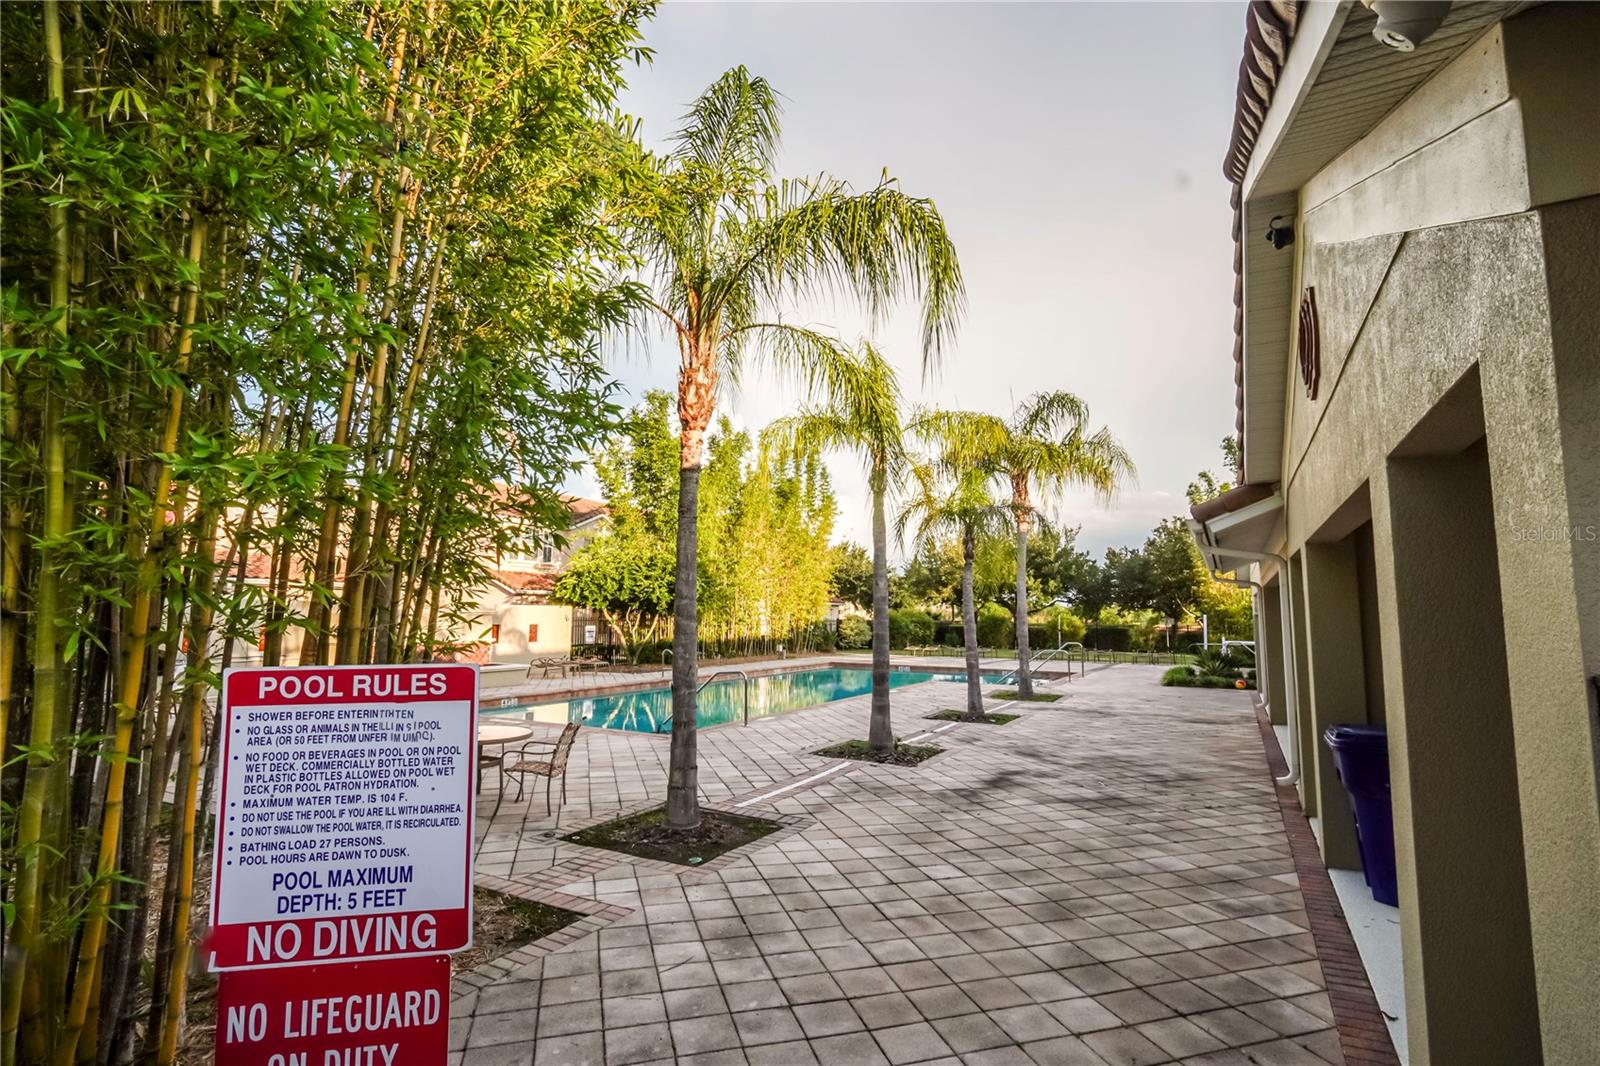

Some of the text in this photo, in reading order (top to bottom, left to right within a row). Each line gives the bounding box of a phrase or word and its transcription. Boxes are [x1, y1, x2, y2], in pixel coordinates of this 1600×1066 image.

[259, 673, 447, 699] POOL RULES
[248, 712, 292, 721] SHOWER
[296, 711, 335, 720] BEFORE
[248, 726, 260, 735] NO
[264, 725, 293, 734] GLASS
[296, 725, 308, 733] OR
[311, 723, 349, 733] ANIMALS
[352, 723, 359, 731] IN
[247, 737, 272, 746] AREA
[276, 736, 291, 747] (OR
[295, 735, 305, 744] 50
[307, 735, 329, 744] FEET
[331, 733, 356, 743] FROM
[246, 746, 461, 762] NO FOOD OR BEVERAGES IN POOL OR ON POOL
[246, 757, 453, 772] WET DECK. COMMERCIALLY BOTTLED WATER
[244, 767, 455, 783] IN PLASTIC BOTTLES ALLOWED ON POOL WET
[244, 779, 419, 794] DECK FOR POOL PATRON HYDRATION.
[243, 793, 407, 808] MAXIMUM WATER TEMP. IS 104 F.
[242, 804, 463, 822] DO NOT USE THE POOL IF YOU ARE ILL WITH DIARRHEA.
[241, 817, 461, 837] DO NOT SWALLOW THE POOL WATER, IT IS RECIRCULATED.
[241, 836, 385, 852] BATHING LOAD 27 PERSONS.
[240, 848, 409, 866] POOL HOURS ARE DAWN TO DUSK.
[273, 865, 413, 891] POOL MAXIMUM
[277, 889, 406, 914] DEPTH: 5 FEET
[247, 913, 437, 962] NO DIVING
[226, 989, 441, 1044] NO LIFEGUARD
